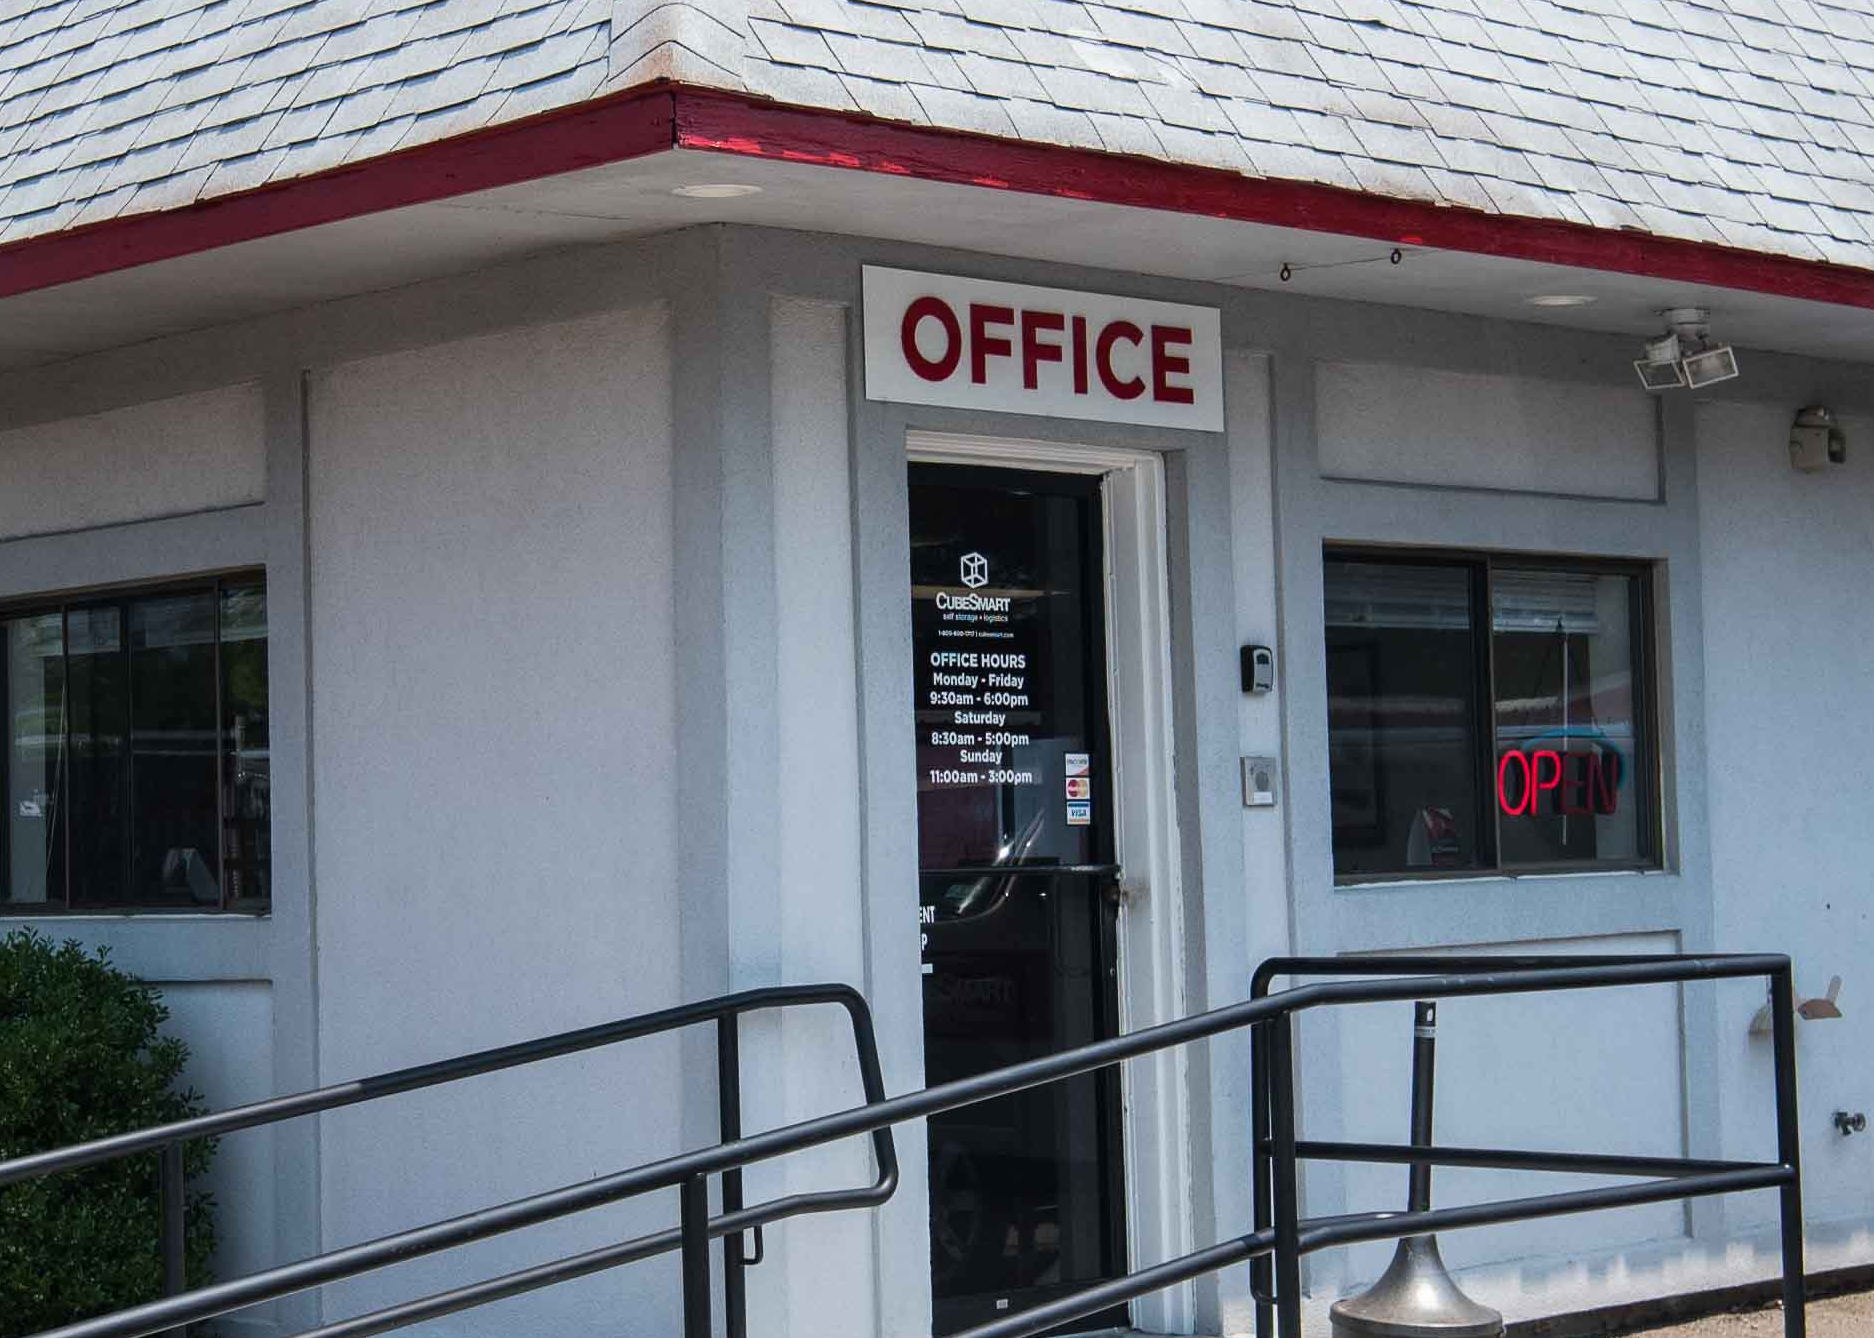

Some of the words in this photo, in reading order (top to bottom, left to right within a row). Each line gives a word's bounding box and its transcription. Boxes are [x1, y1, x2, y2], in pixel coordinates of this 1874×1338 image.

[900, 295, 1195, 405] OFFICE
[983, 612, 1009, 624] logistics
[930, 652, 978, 667] OFFICE
[981, 653, 1026, 669] HOURS
[933, 672, 978, 688] Monday
[988, 673, 1024, 690] Friday
[929, 691, 974, 705] 9:30am
[983, 692, 1029, 708] 6:00pm
[954, 710, 1006, 727] Saturday
[931, 732, 975, 745] 8:30am
[985, 732, 1029, 748] 5:00pm
[960, 749, 1003, 765] Sunday
[929, 769, 978, 784] 11:00am
[988, 770, 1033, 786] 3:00pm
[1497, 749, 1618, 816] OPEN
[1071, 808, 1087, 817] VISA
